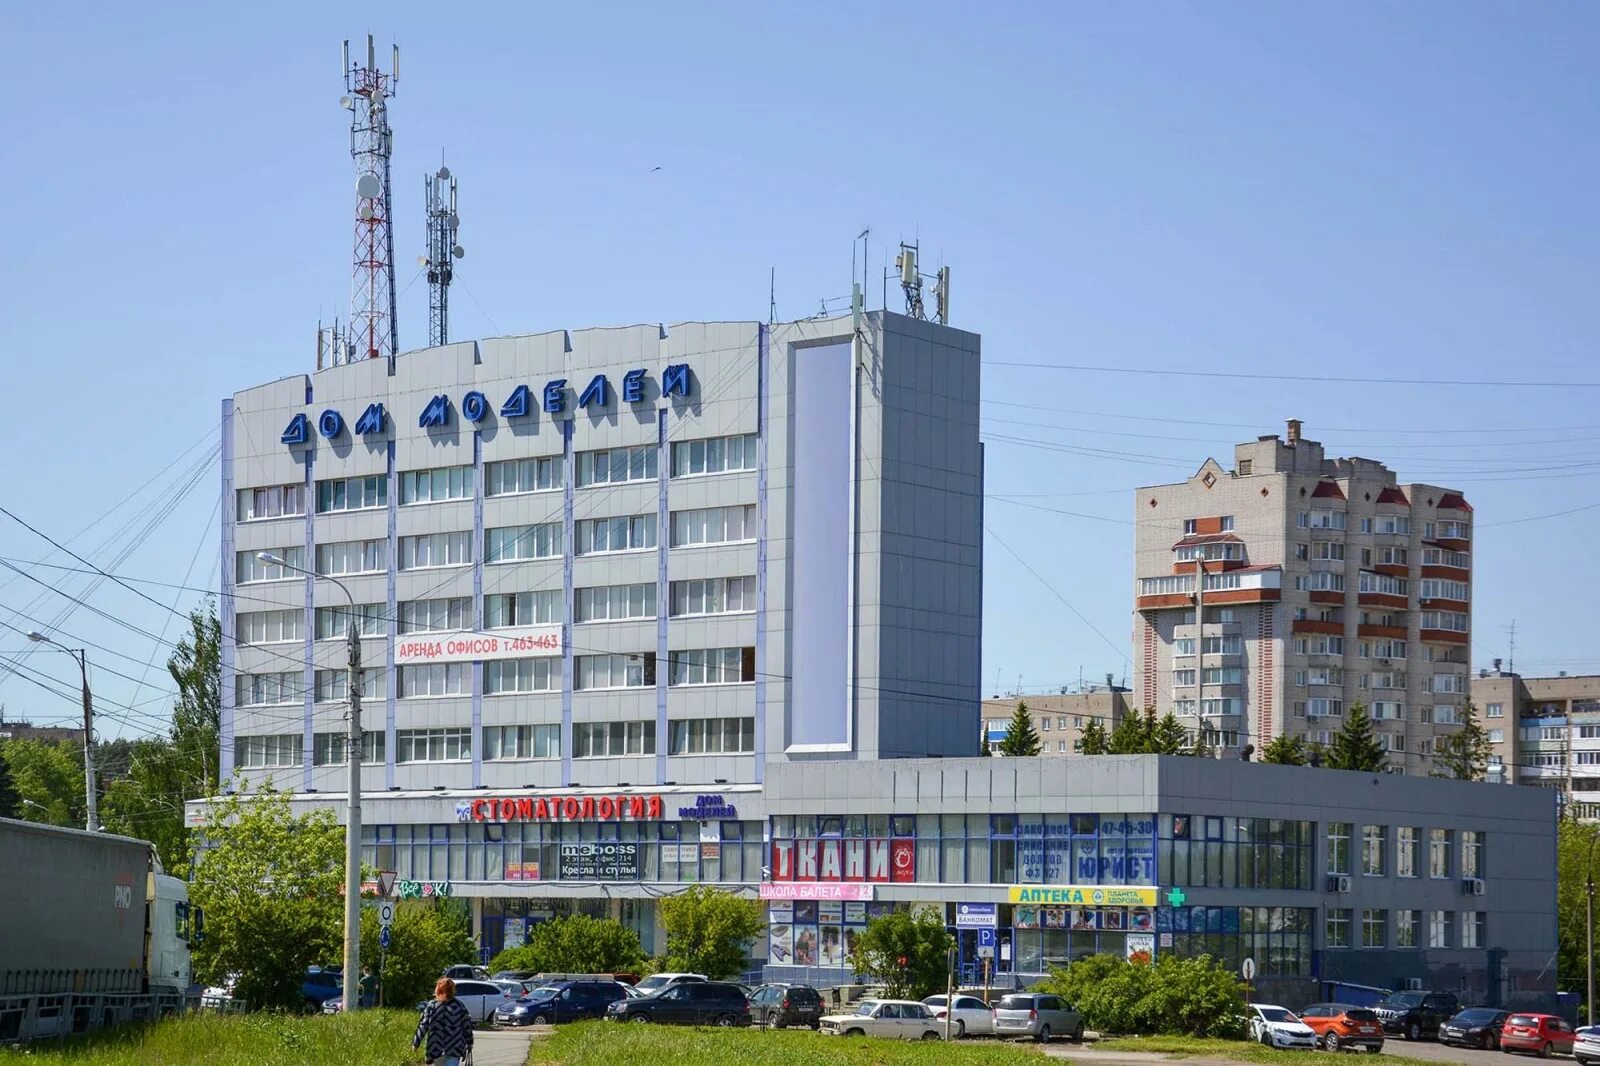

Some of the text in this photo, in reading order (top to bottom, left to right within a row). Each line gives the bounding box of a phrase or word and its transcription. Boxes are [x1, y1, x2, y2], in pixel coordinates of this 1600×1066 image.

[281, 363, 691, 444] ДОМ МОДЕЛЕЙ
[399, 642, 443, 658] АРЕНДА
[447, 639, 498, 655] ОФИСОВ
[471, 794, 663, 821] СТОМАТОЛОГИЯ
[696, 795, 723, 807] ДОМ
[678, 804, 735, 819] МОДЕЛЕЙ
[1017, 824, 1069, 835] ЗАКОННОЕ
[1017, 841, 1069, 851] СПИСАНИЕ
[775, 840, 888, 878] ТКАНИ
[562, 865, 594, 875] Кресла
[605, 866, 637, 876] стулья
[1078, 857, 1153, 879] ЮРИСТ
[759, 886, 842, 897] ШКОЛА БАЛЕТА
[1019, 888, 1084, 903] АПТЕКА
[958, 916, 994, 924] БАНКОМАТ
[982, 930, 991, 945] P
